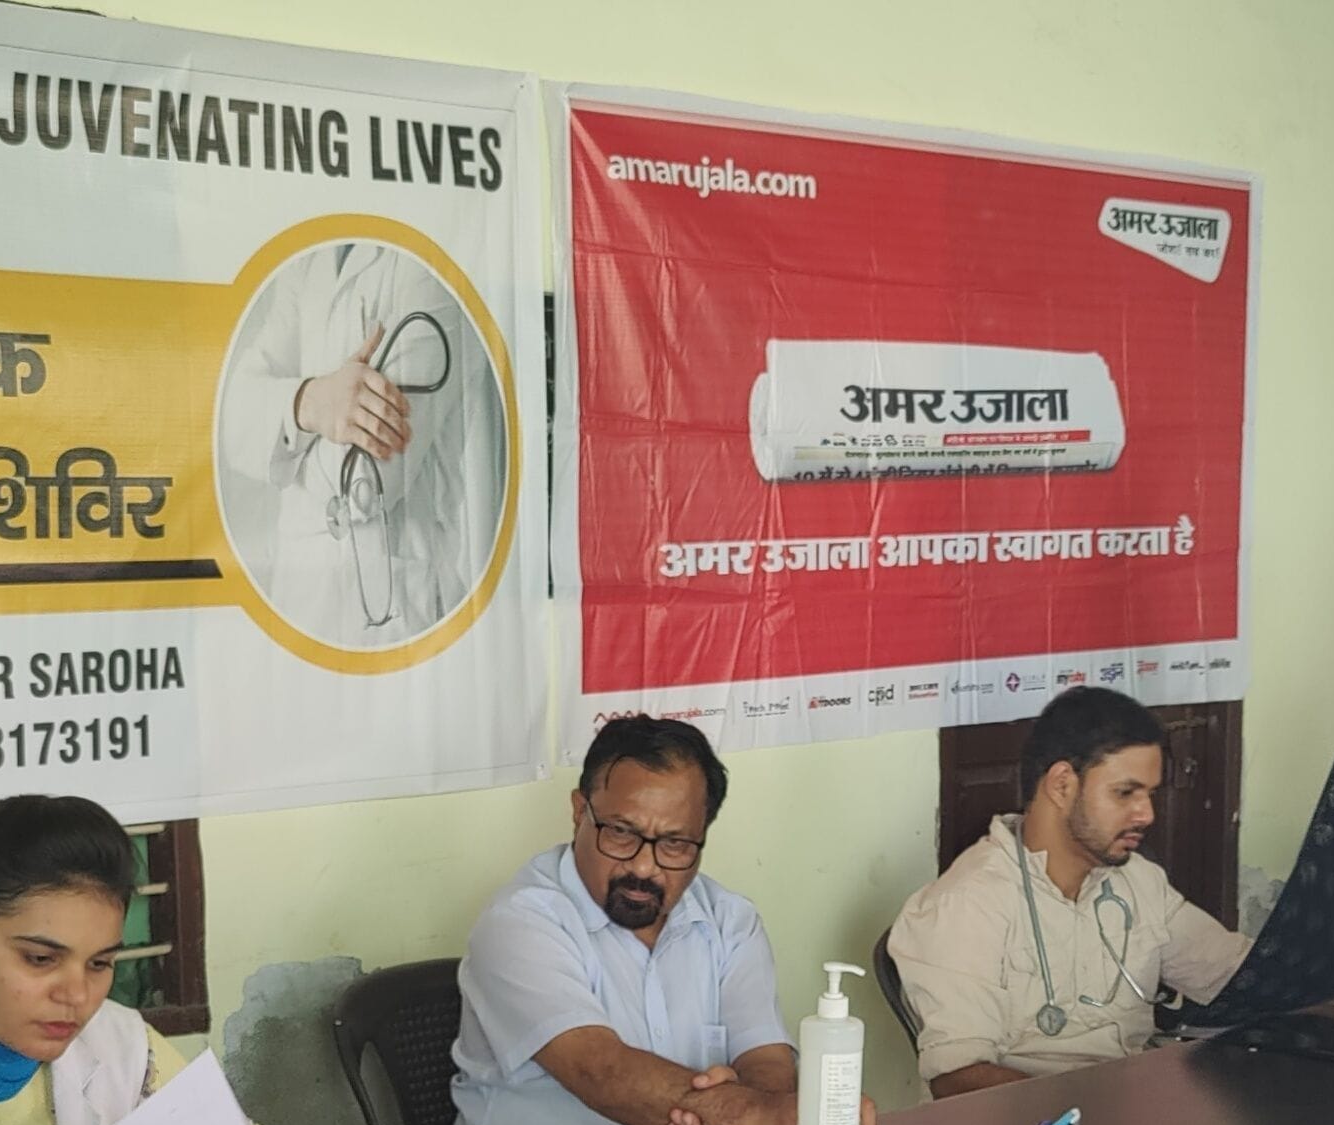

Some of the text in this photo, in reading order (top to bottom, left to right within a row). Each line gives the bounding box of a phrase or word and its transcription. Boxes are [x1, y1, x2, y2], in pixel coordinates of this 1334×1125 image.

[369, 115, 503, 192] LIVES
[607, 155, 817, 199] amarujala.com
[1107, 207, 1219, 241] अमर उजाला
[839, 384, 1069, 424] अमर उजाला
[659, 514, 1195, 577] अमर उजाला आपका स्वागत करता है
[29, 646, 185, 698] SAROHA
